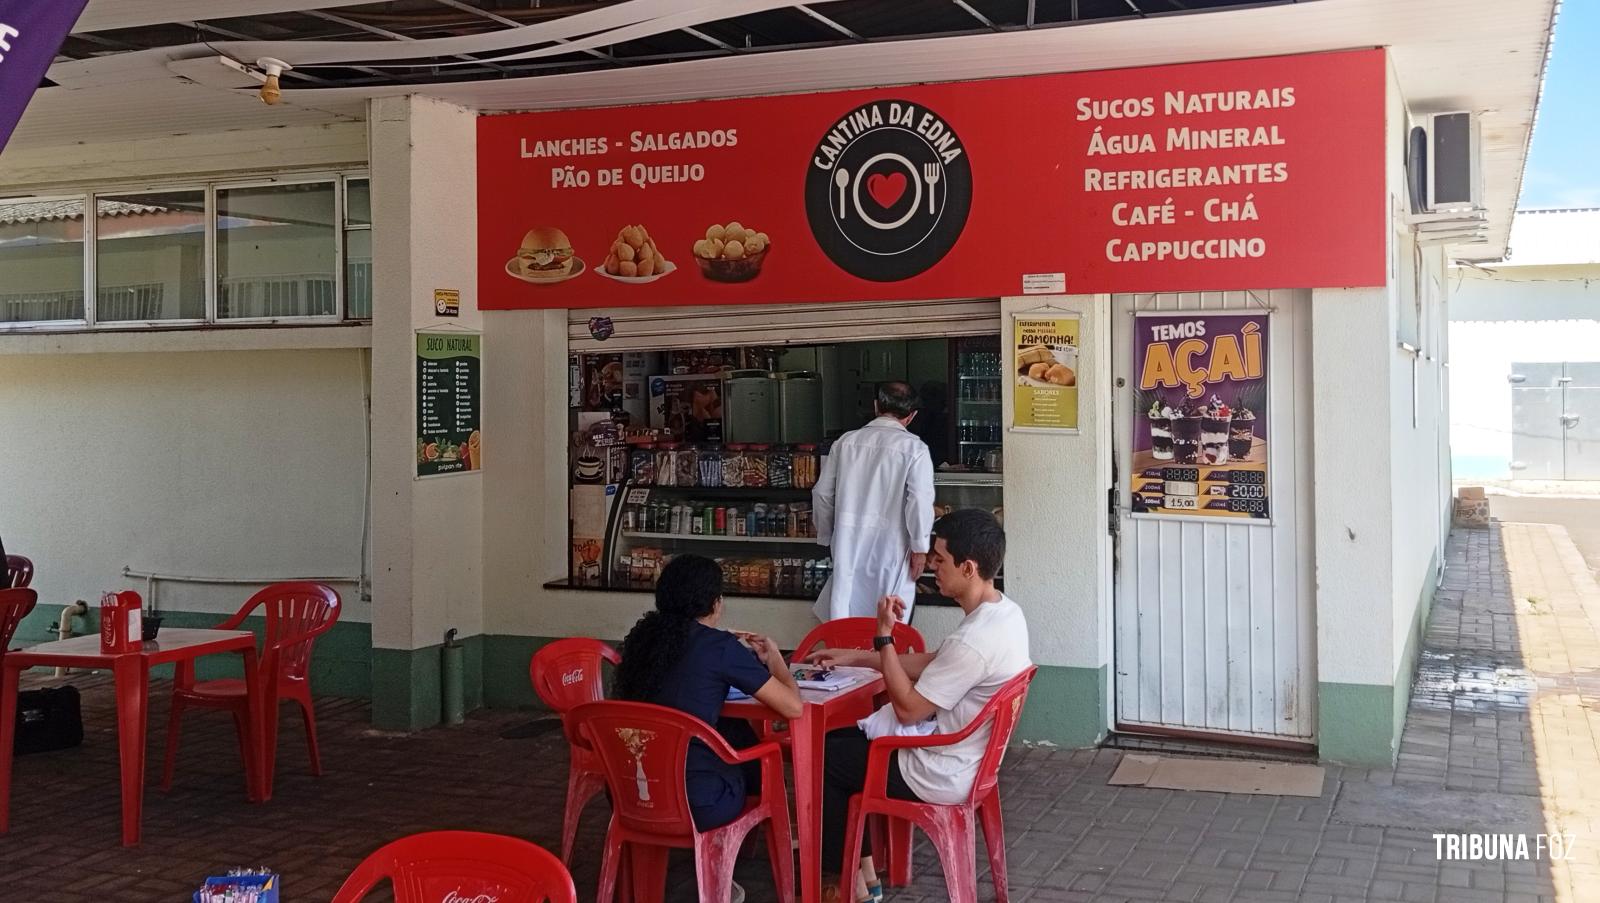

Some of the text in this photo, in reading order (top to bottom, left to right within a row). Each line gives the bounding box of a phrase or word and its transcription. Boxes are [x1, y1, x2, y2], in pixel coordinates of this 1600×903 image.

[1076, 86, 1296, 121] SUCOS NATURAIS
[520, 136, 609, 159] LANCHES
[630, 128, 738, 153] SALGADOS
[814, 103, 962, 171] CANTINA DA EDNA
[1087, 125, 1286, 156] ÁGUA MINERAL
[551, 163, 705, 190] PÃO DE QUEIJO
[1084, 162, 1289, 192] REFRIGERANTES
[1111, 196, 1176, 226] CAFÉ
[1203, 192, 1259, 223] CHÁ
[1105, 237, 1266, 262] CAPPUCCINO
[426, 337, 473, 352] SUCO NATURAL
[1151, 320, 1206, 342] TEMOS
[1140, 320, 1264, 399] AÇAÍ
[1170, 497, 1195, 508] 15,00
[1232, 484, 1264, 499] 20,00
